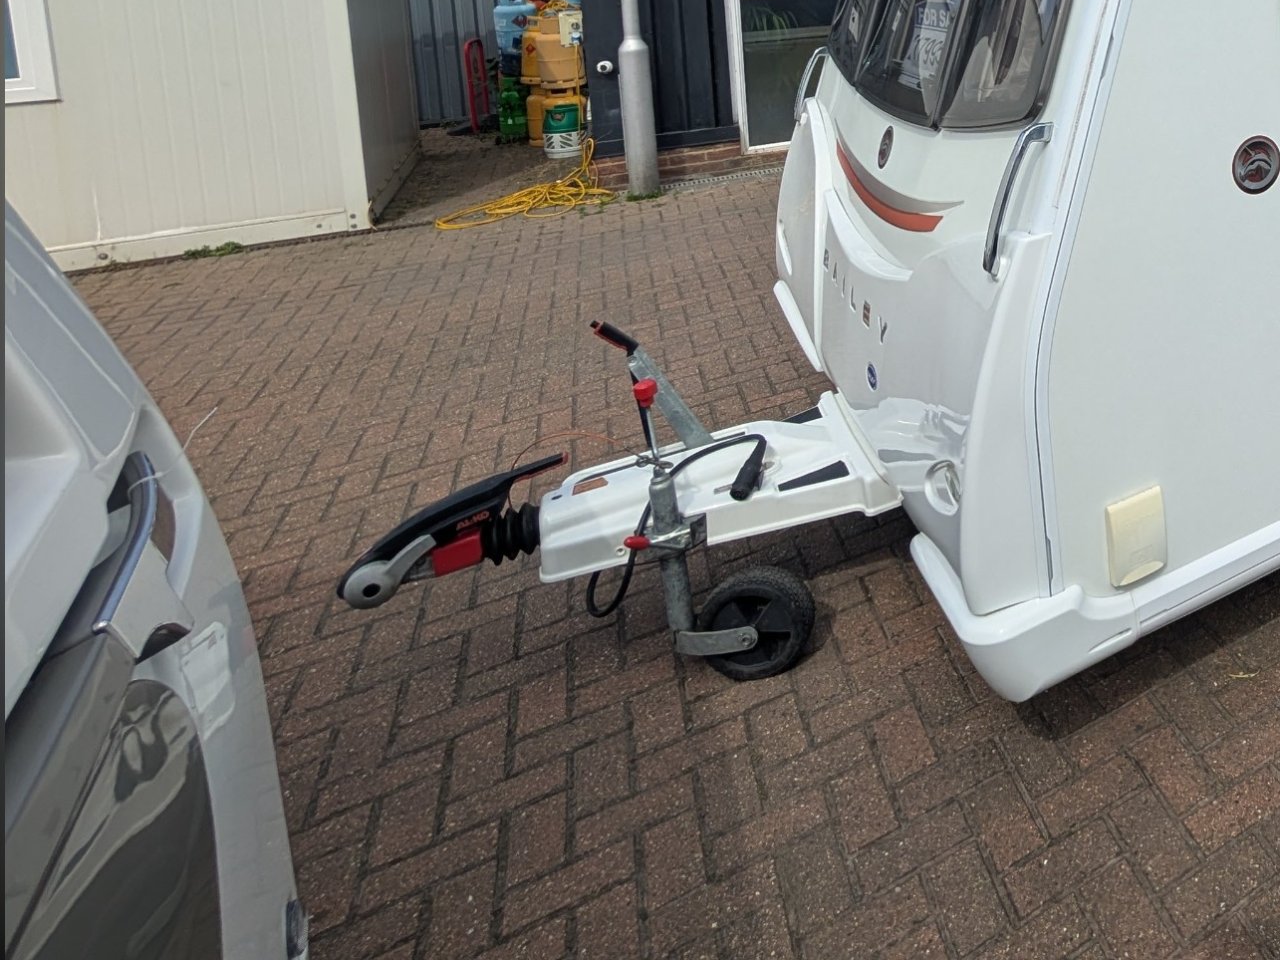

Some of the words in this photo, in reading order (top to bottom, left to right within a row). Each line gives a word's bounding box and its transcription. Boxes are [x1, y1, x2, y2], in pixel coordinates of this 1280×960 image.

[917, 6, 937, 26] FOR
[940, 9, 950, 28] SA
[823, 248, 888, 345] BAILEY
